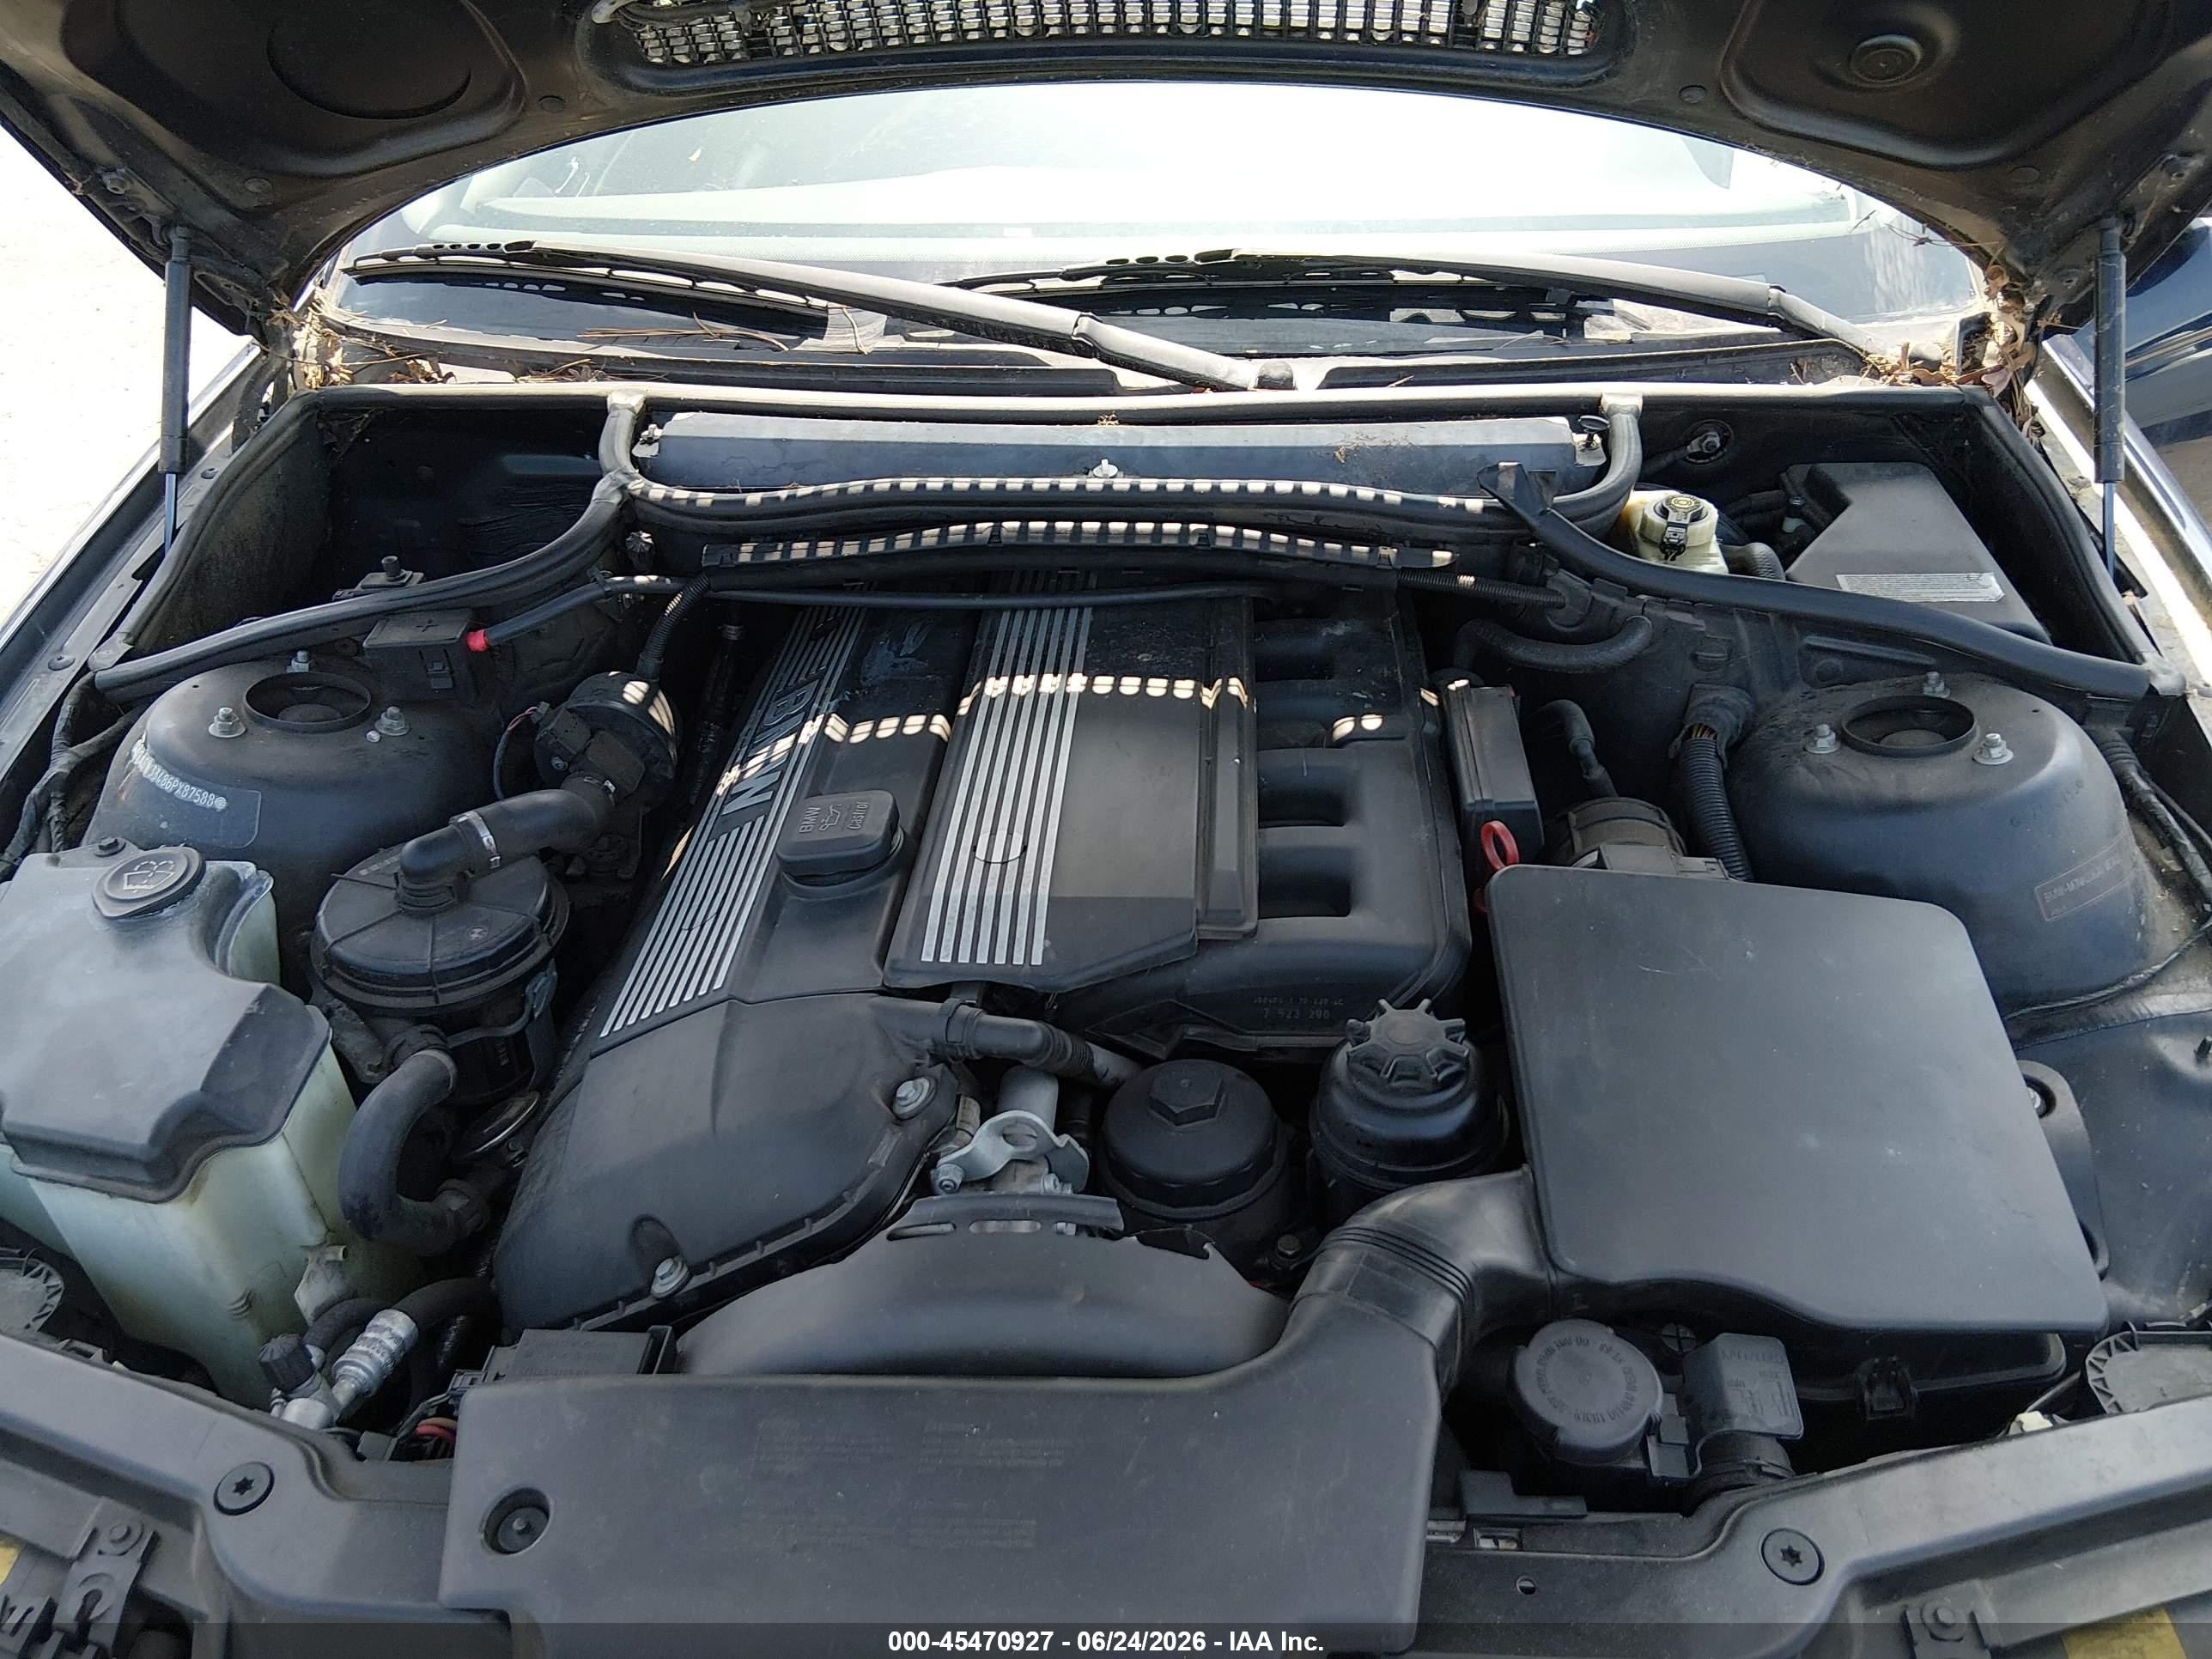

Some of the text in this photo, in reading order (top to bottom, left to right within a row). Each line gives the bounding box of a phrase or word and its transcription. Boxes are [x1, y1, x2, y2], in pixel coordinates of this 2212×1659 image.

[721, 680, 818, 816] BMW
[799, 806, 821, 834] BMW
[847, 801, 870, 830] Castrol
